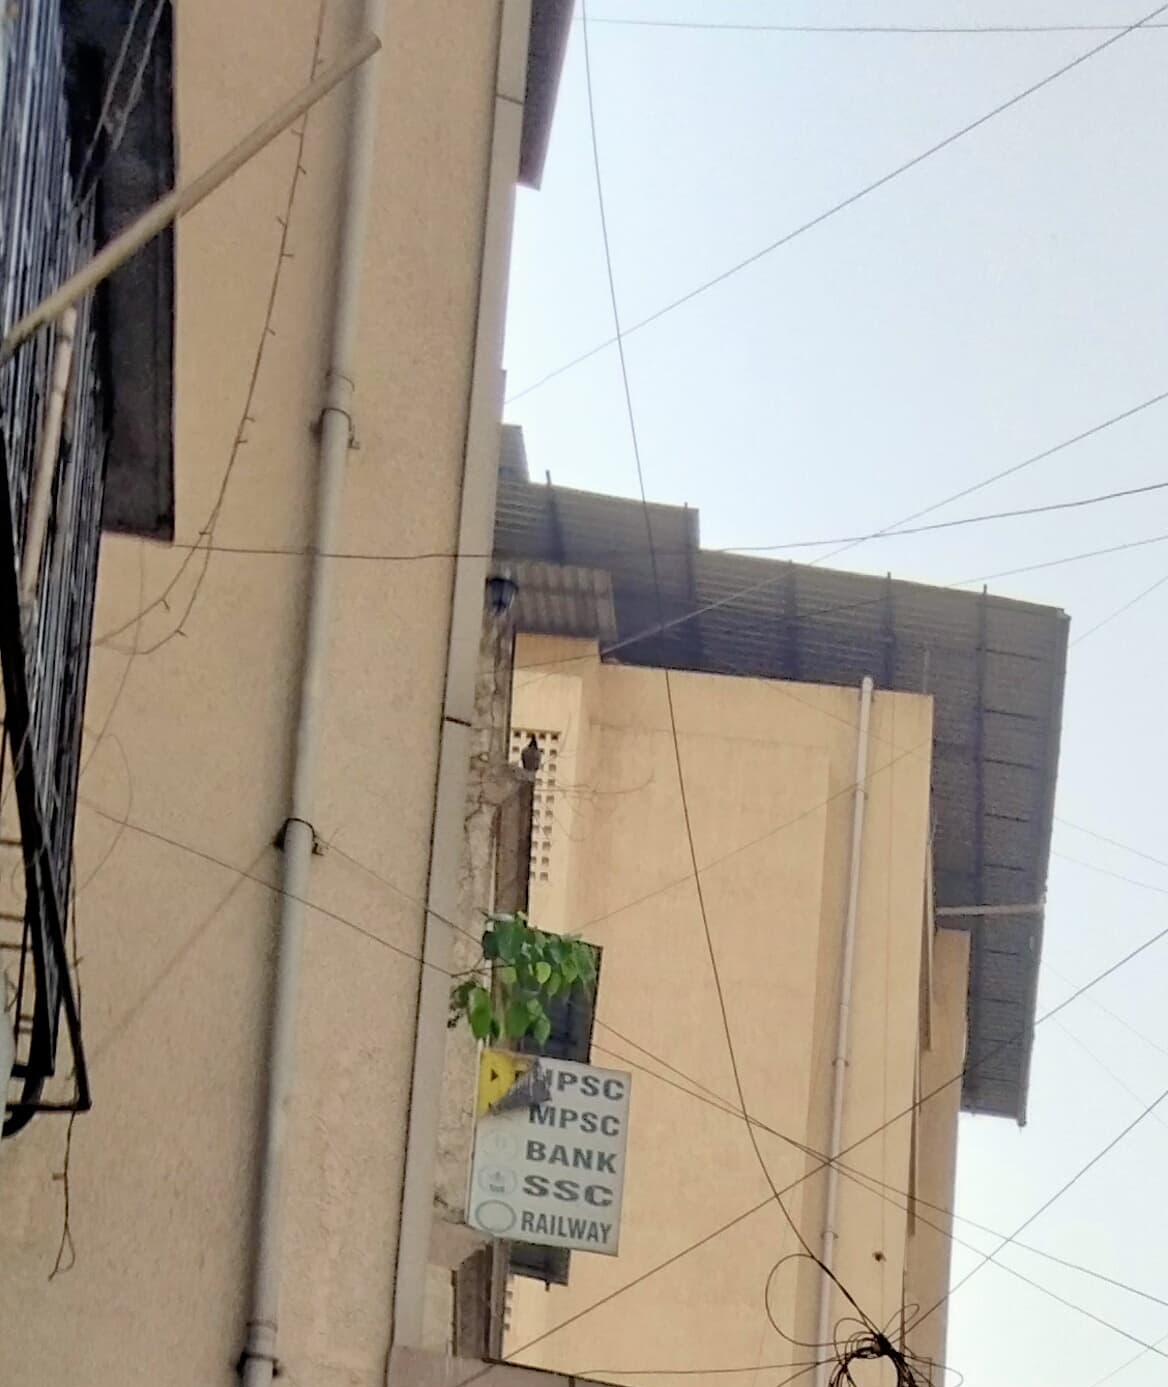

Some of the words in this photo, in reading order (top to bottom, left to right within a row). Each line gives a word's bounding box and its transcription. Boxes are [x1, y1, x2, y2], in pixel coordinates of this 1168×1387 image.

[529, 1104, 620, 1137] MPSC
[525, 1140, 617, 1174] BANK
[522, 1175, 614, 1207] SSC
[520, 1210, 612, 1244] RAILWAY
